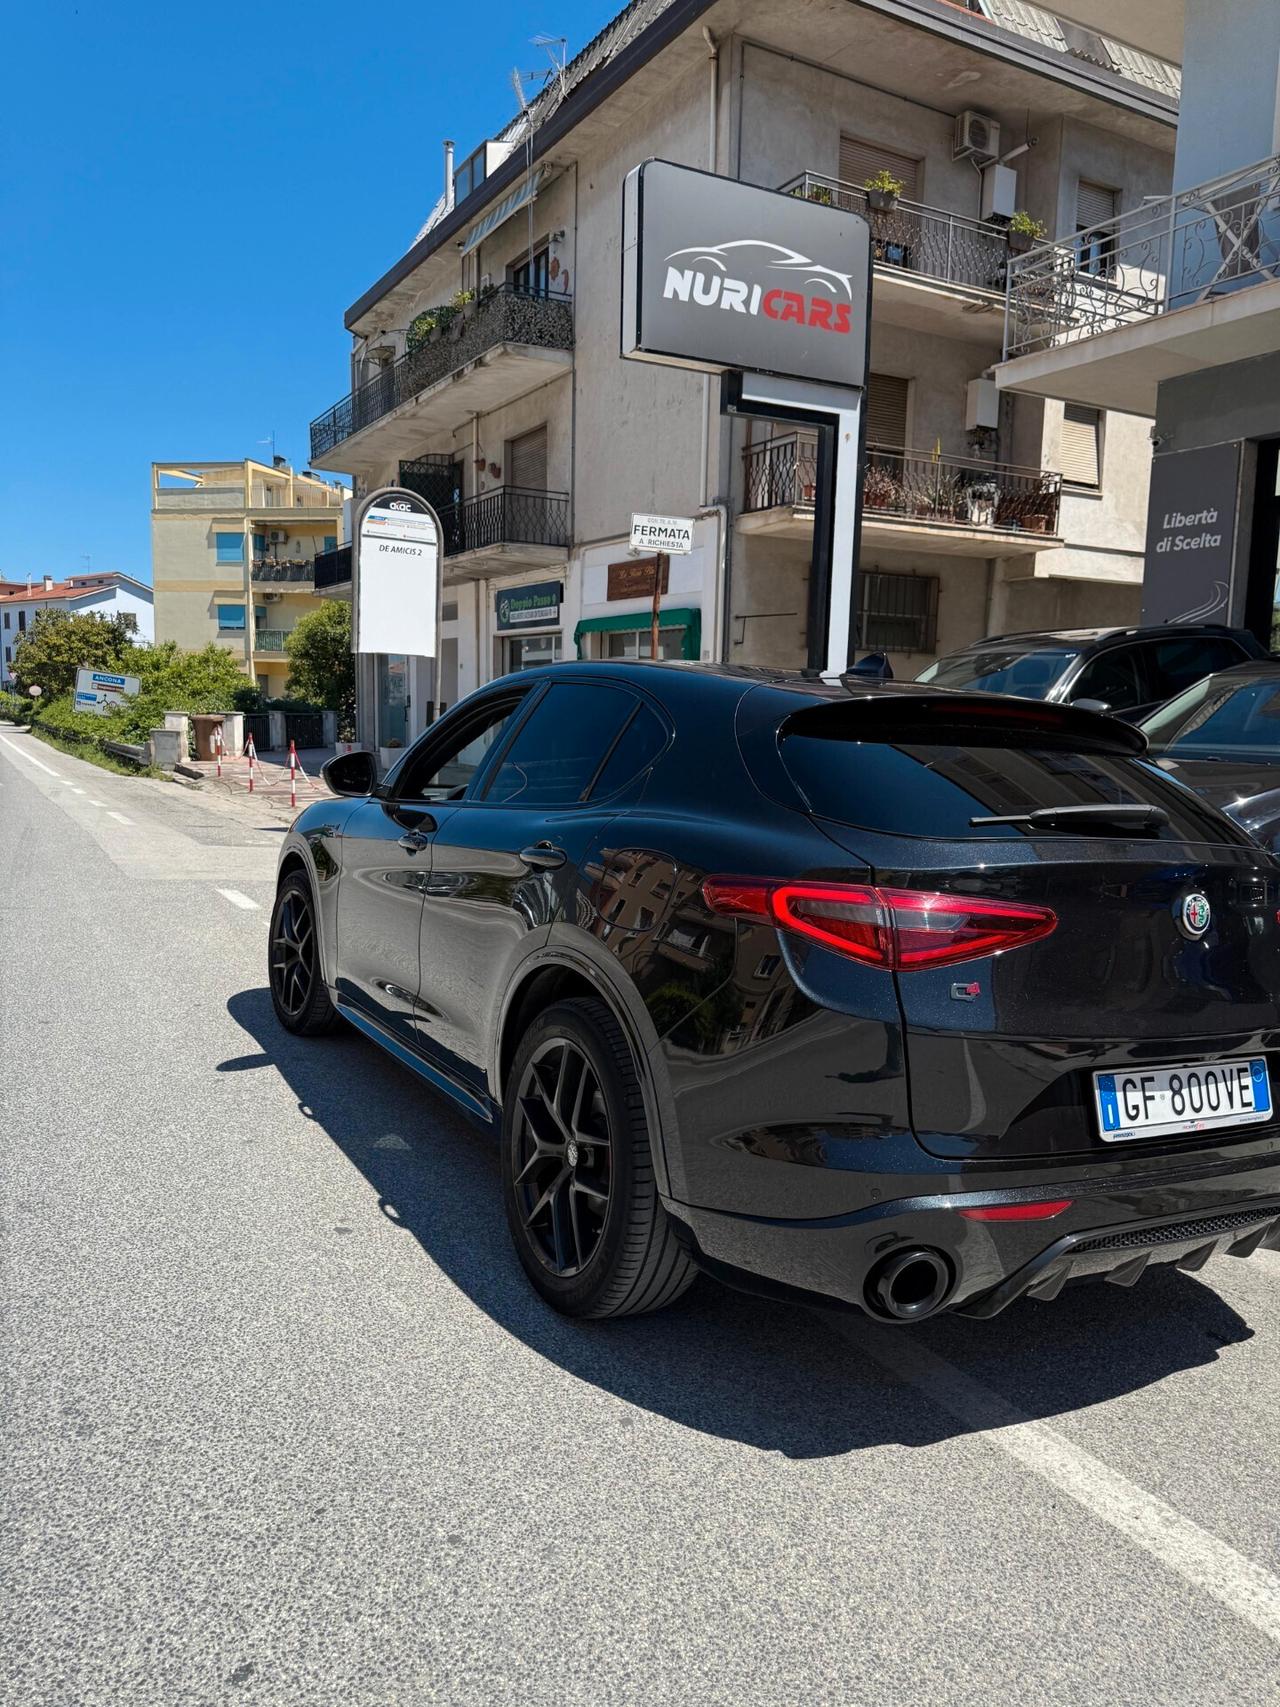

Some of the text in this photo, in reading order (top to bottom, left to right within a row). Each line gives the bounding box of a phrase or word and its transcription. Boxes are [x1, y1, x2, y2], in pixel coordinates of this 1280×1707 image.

[1163, 507, 1218, 529] Libertà
[633, 525, 690, 540] FERMATA
[379, 544, 390, 552] DE
[390, 546, 416, 556] AMICIS
[647, 538, 684, 549] RICHIESTA
[1156, 532, 1222, 553] di Scelta
[94, 675, 121, 683] ANCONA
[1122, 1067, 1252, 1122] GF 800VE
